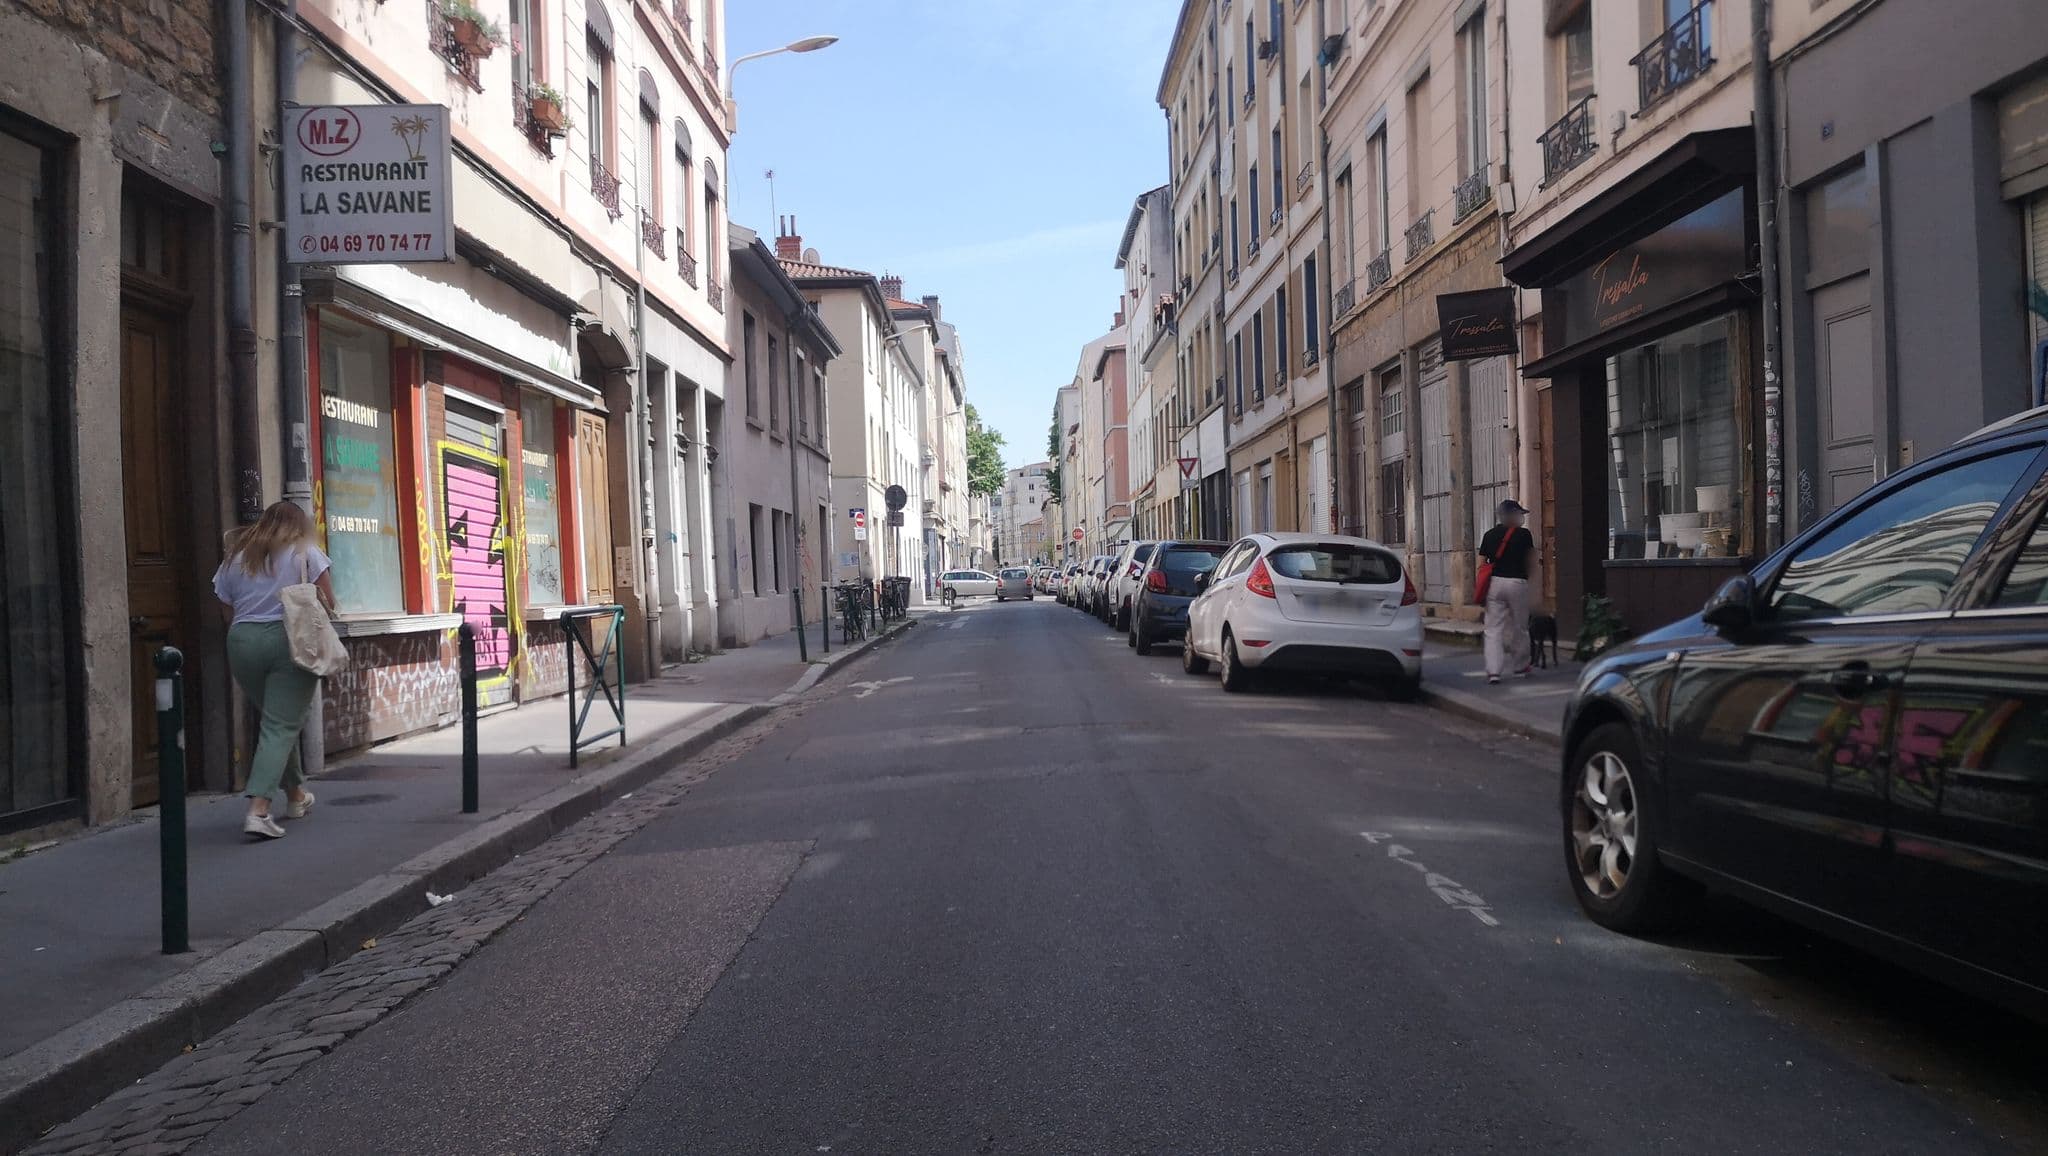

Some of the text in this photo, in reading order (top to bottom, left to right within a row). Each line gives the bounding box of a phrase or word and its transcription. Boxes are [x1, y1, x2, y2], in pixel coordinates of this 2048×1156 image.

[309, 118, 349, 145] M.Z
[301, 162, 429, 183] RESTAURANT
[300, 190, 431, 215] LA SAVANE
[320, 233, 432, 252] 04 69 70 74 77
